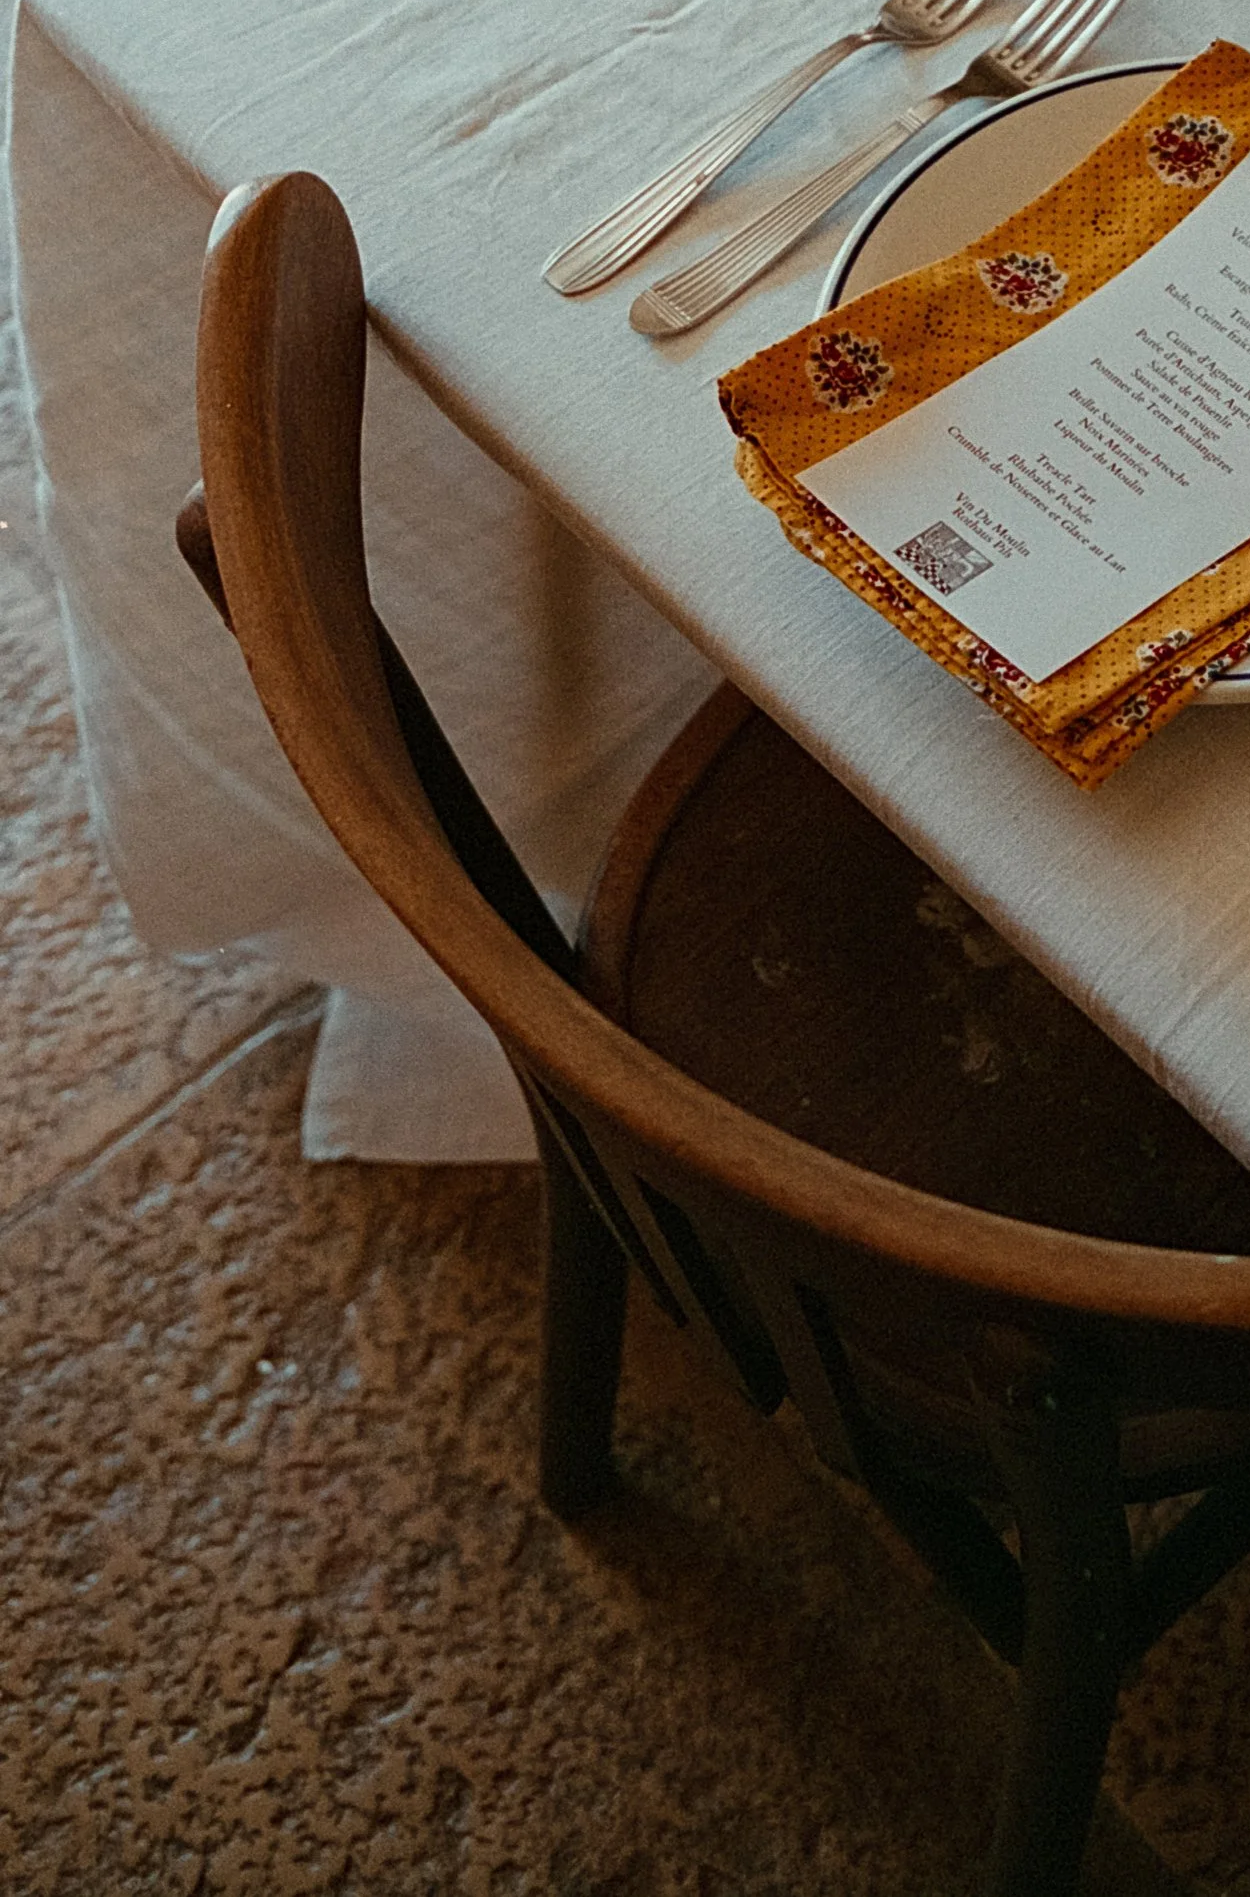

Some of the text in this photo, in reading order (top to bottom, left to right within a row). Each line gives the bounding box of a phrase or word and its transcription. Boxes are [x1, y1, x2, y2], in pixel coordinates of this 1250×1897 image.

[1089, 357, 1133, 394] Pommes
[1130, 390, 1146, 404] de
[1145, 401, 1174, 426] Terre
[1130, 367, 1221, 442] Sauce au vin rouge
[1147, 358, 1179, 387] Salade
[1177, 384, 1193, 397] de
[1053, 418, 1145, 496] Liqueur du Moulin
[1078, 416, 1104, 442] Noix
[1101, 411, 1136, 445] Savarin
[1134, 442, 1153, 457] sur
[1150, 453, 1190, 487] brioche
[946, 425, 991, 464] Crumble
[988, 462, 1004, 475] de
[1047, 510, 1062, 522] et
[1059, 519, 1091, 545] Glace
[1088, 544, 1105, 557] au
[1035, 452, 1073, 486] Treacle
[951, 506, 1013, 559] Rothaus Pils
[955, 491, 1031, 558] Vin Du Moulin
